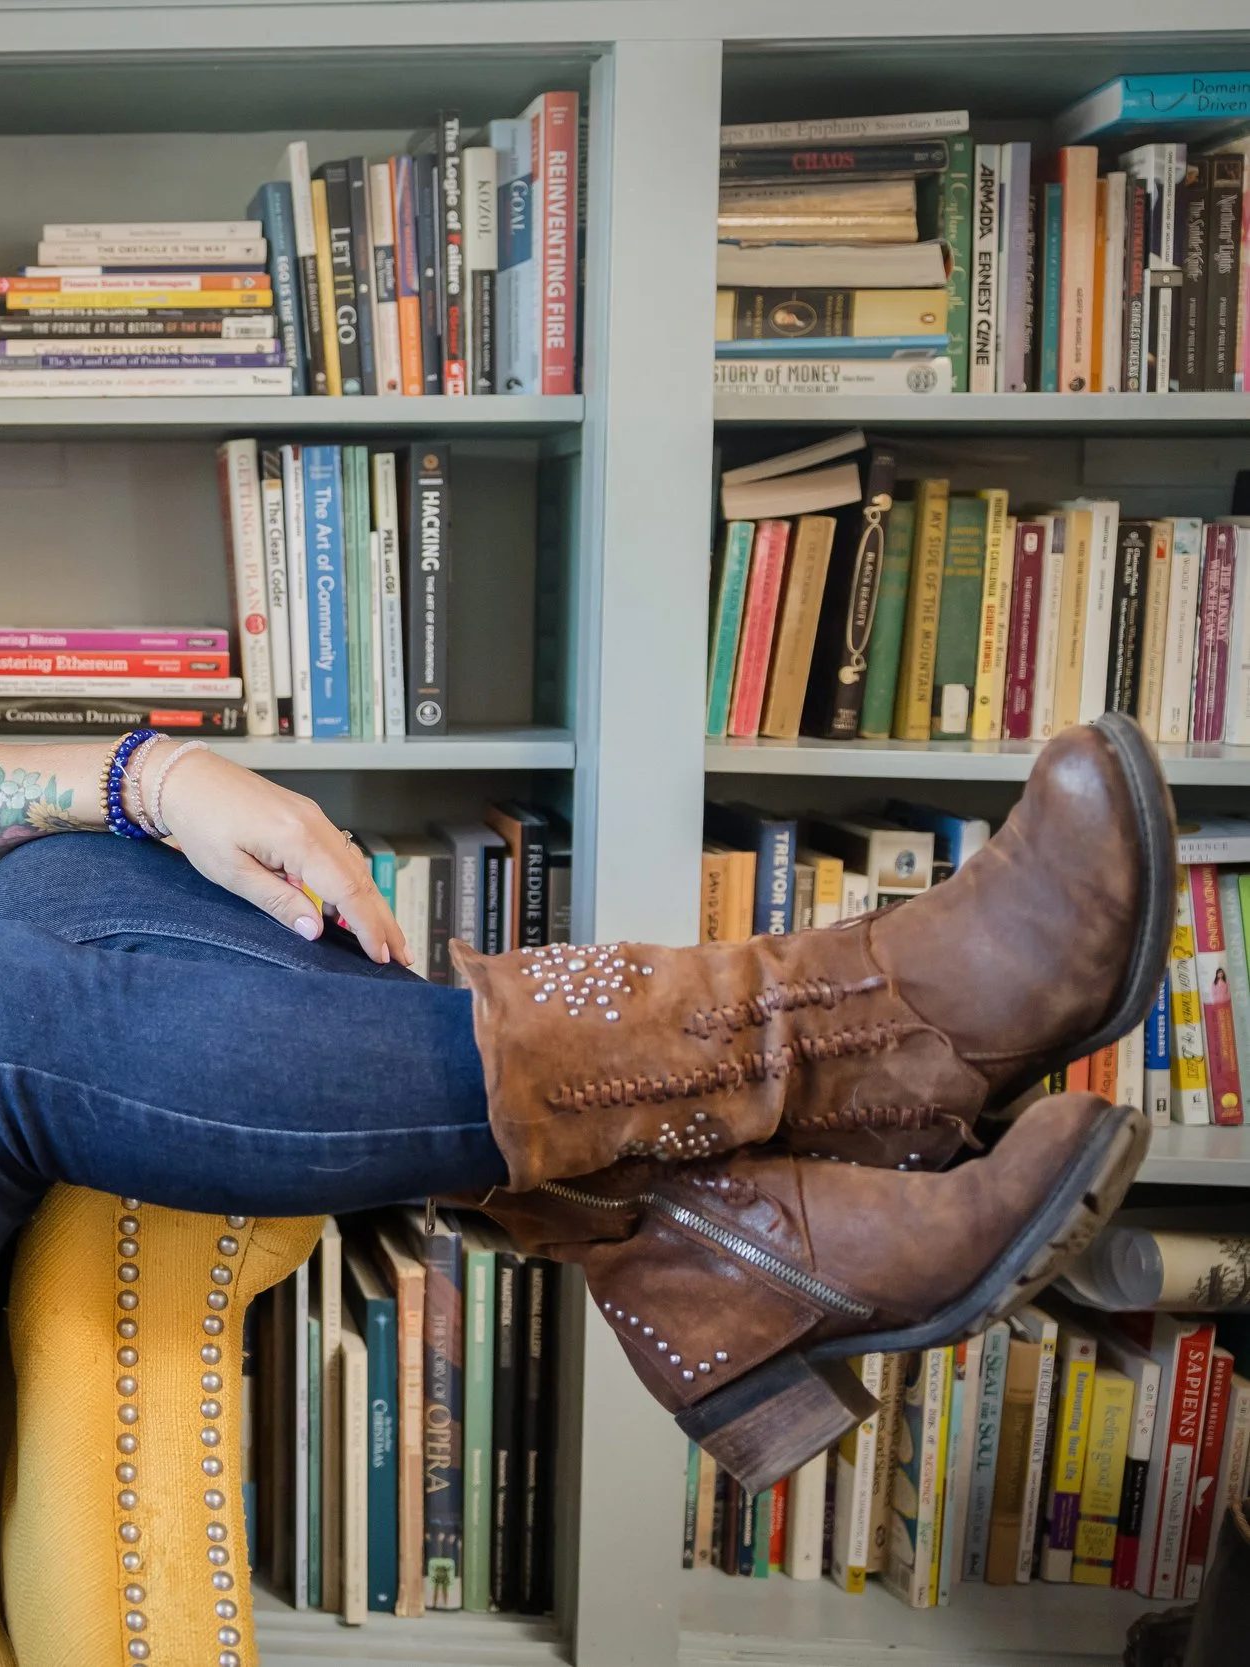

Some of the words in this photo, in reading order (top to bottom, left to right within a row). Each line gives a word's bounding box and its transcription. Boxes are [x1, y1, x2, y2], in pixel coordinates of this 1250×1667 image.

[1197, 94, 1248, 113] Driven
[445, 118, 459, 152] The
[749, 126, 766, 141] to
[773, 122, 792, 139] the
[797, 117, 870, 142] Epiphany
[875, 118, 907, 131] Steven
[909, 116, 933, 131] Gary
[792, 151, 855, 171] CHAOS
[443, 156, 460, 205] Logic
[477, 180, 494, 240] KOZOL
[978, 163, 996, 239] ARMADA
[445, 210, 461, 231] of
[547, 151, 567, 297] REINVENTING
[97, 244, 117, 254] THE
[118, 243, 167, 254] OBSTACLE
[181, 243, 200, 253] THE
[331, 227, 352, 268] LET
[276, 255, 291, 281] EGO
[335, 274, 355, 299] IT
[976, 250, 993, 314] ERNEST
[278, 283, 292, 298] IS
[280, 299, 295, 323] THE
[337, 304, 358, 347] GO
[546, 302, 565, 349] FIRE
[86, 344, 185, 355] INTELLIGENCE
[283, 325, 299, 367] ENEMY
[975, 319, 992, 366] CLINE
[765, 363, 784, 386] of
[788, 362, 842, 383] MONEY
[268, 500, 282, 525] The
[314, 487, 333, 520] The
[236, 455, 256, 537] GETTING
[246, 563, 262, 611] PLAN
[269, 528, 283, 566] Clean
[316, 522, 335, 550] Art
[421, 491, 441, 572] HACKING
[317, 554, 334, 575] of
[926, 535, 942, 567] SIDE
[271, 569, 285, 609] Coder
[924, 571, 938, 592] OF
[1220, 563, 1232, 590] THE
[317, 576, 338, 671] Community
[922, 594, 937, 624] THE
[55, 654, 129, 673] Ethereum
[916, 628, 934, 703] MOUNTAIN
[5, 708, 84, 724] CONTINUOUS
[85, 709, 143, 724] DELIVERY
[461, 855, 476, 893] HIGH
[526, 844, 544, 920] FREDDIE
[772, 831, 790, 905] TREVOR
[1201, 866, 1218, 905] MINDY
[708, 872, 721, 908] DAVID
[461, 896, 476, 929] RISE
[767, 910, 786, 936] NO
[1204, 905, 1222, 951] KALING
[983, 1353, 1004, 1400] SEAT
[1179, 1348, 1205, 1438] SAPIENS
[1069, 1371, 1089, 1431] Reinventing
[426, 1403, 452, 1494] OPERA
[976, 1422, 997, 1473] SOUL
